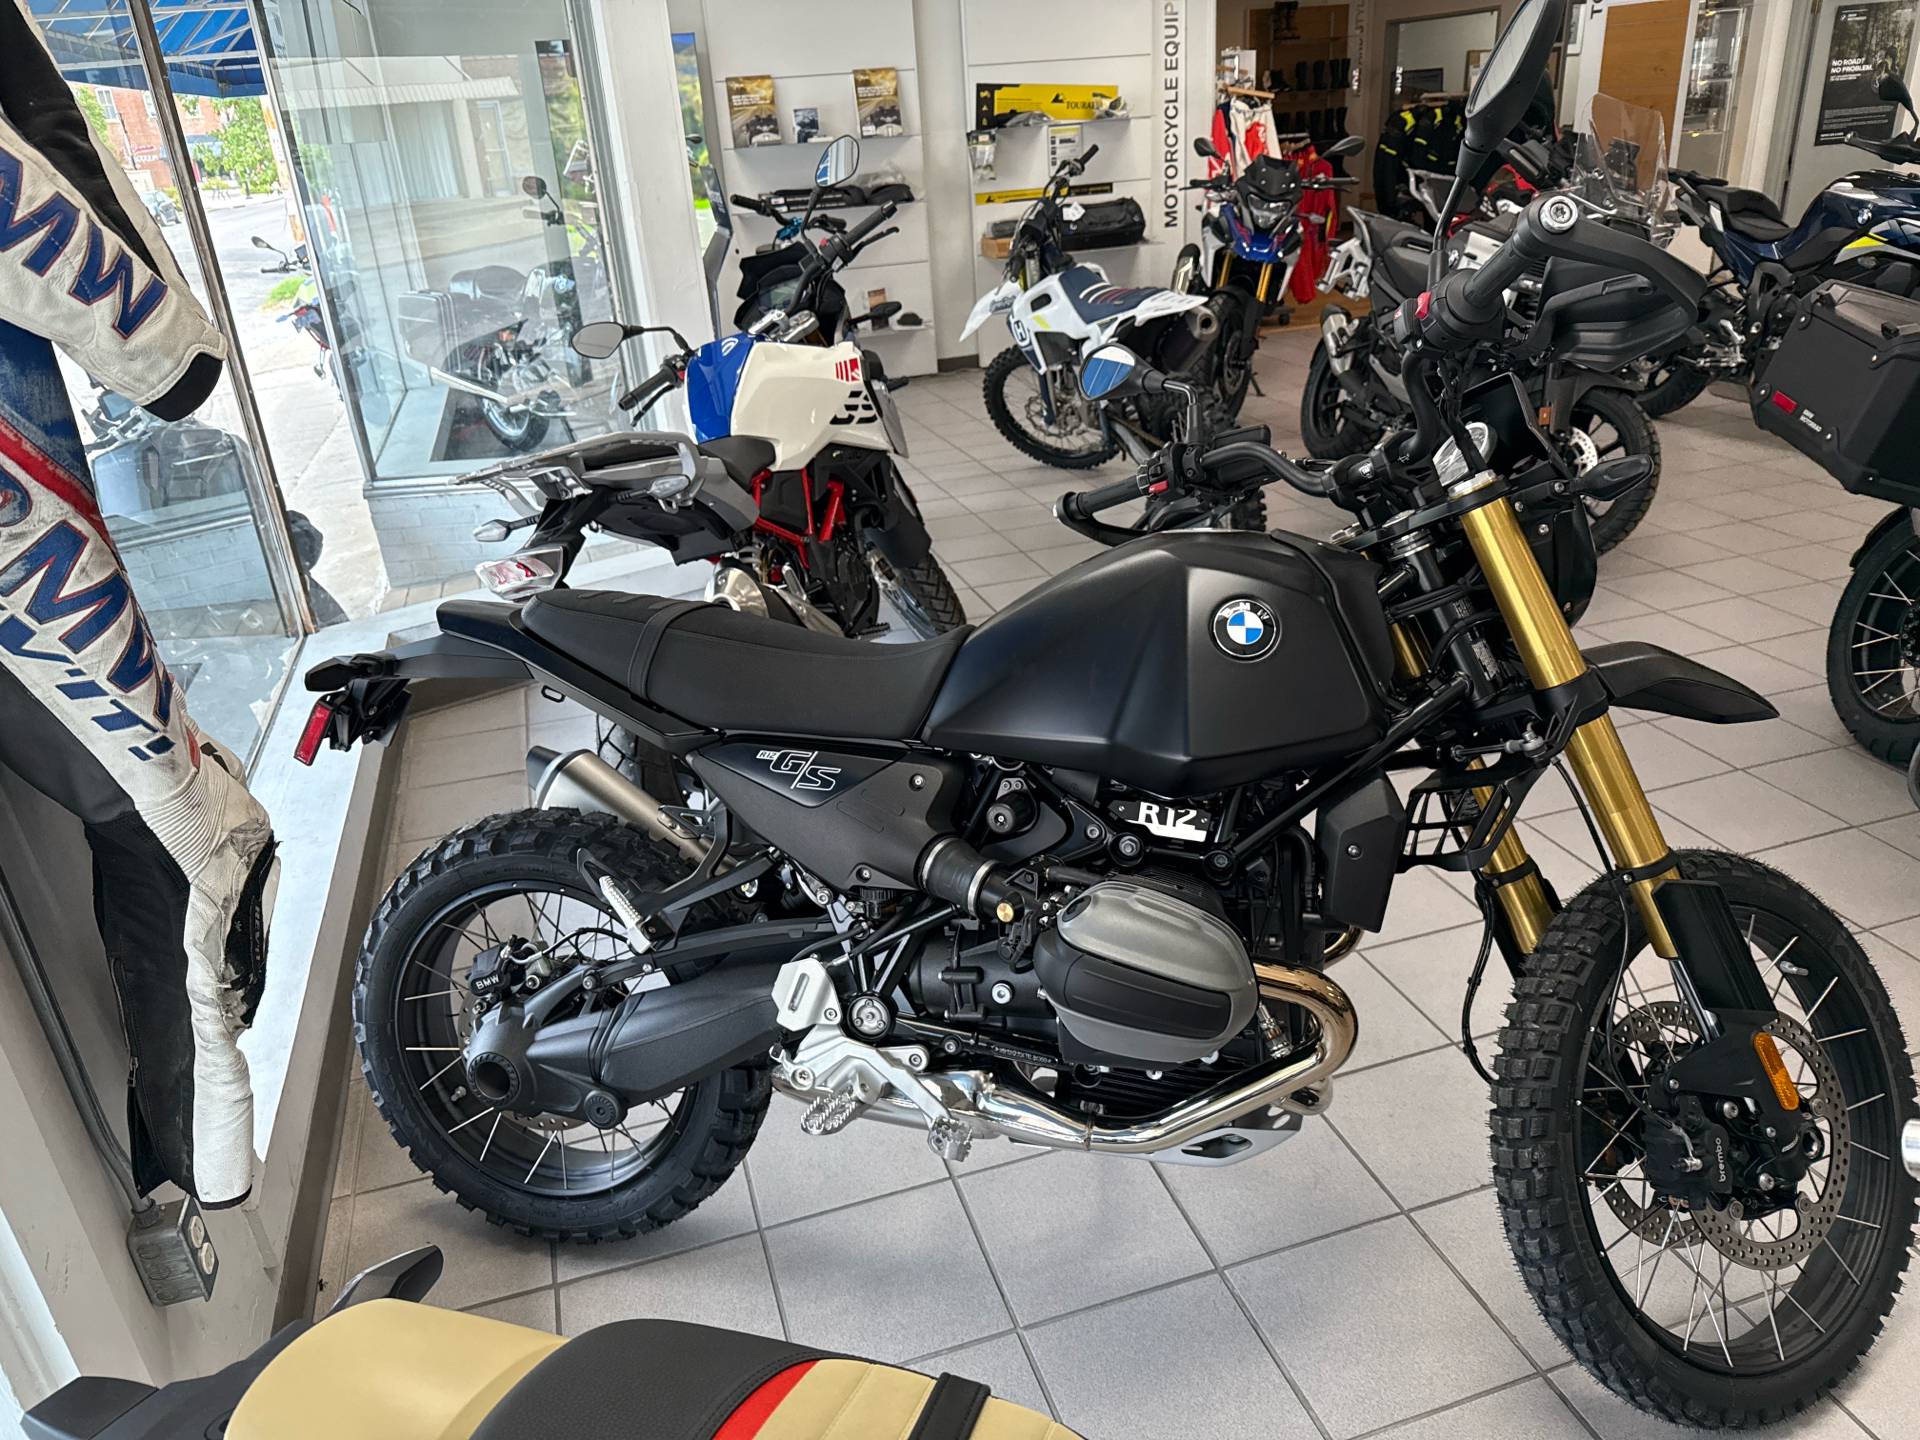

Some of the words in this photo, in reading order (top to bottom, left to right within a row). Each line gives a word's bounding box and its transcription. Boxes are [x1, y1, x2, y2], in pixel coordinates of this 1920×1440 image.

[1164, 1, 1181, 71] EQUIP
[1843, 58, 1866, 66] ROAD?
[1066, 101, 1104, 110] TOURAT
[1164, 76, 1179, 228] MOTORCYCLE
[1219, 602, 1270, 620] BMW
[475, 973, 500, 990] BMW
[1715, 1137, 1727, 1183] brembo
